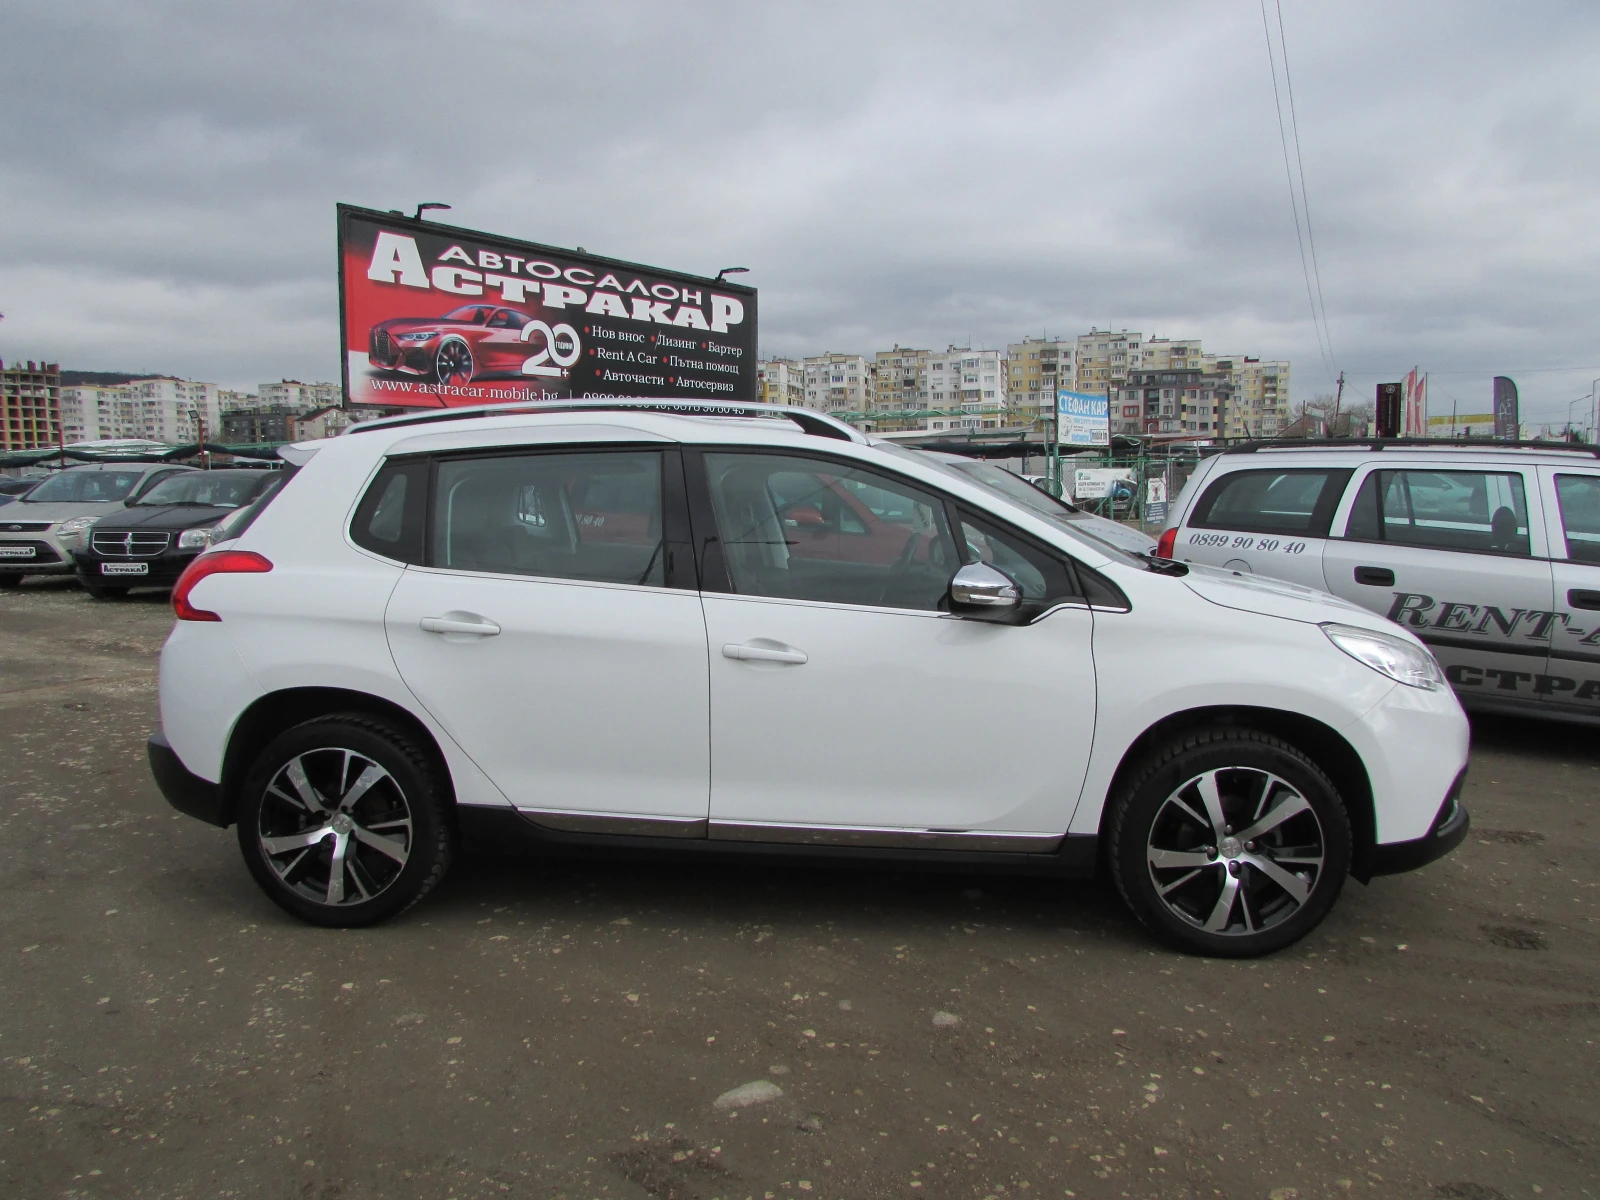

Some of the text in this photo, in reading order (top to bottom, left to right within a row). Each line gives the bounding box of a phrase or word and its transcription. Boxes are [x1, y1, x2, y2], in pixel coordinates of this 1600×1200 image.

[438, 245, 702, 306] АВТОСАЛОН
[592, 325, 645, 343] Нов внос
[657, 334, 697, 350] Лизинг
[597, 347, 658, 365] Rent A Car
[708, 341, 743, 358] Бартер
[670, 356, 740, 376] Пътна помощ
[603, 369, 665, 386] Авточасти
[676, 376, 735, 393] Автосервиз
[1059, 395, 1108, 416] СТЕФАН КАР
[1189, 532, 1306, 555] 0899 90 80 40
[1444, 664, 1600, 700] СТРА
